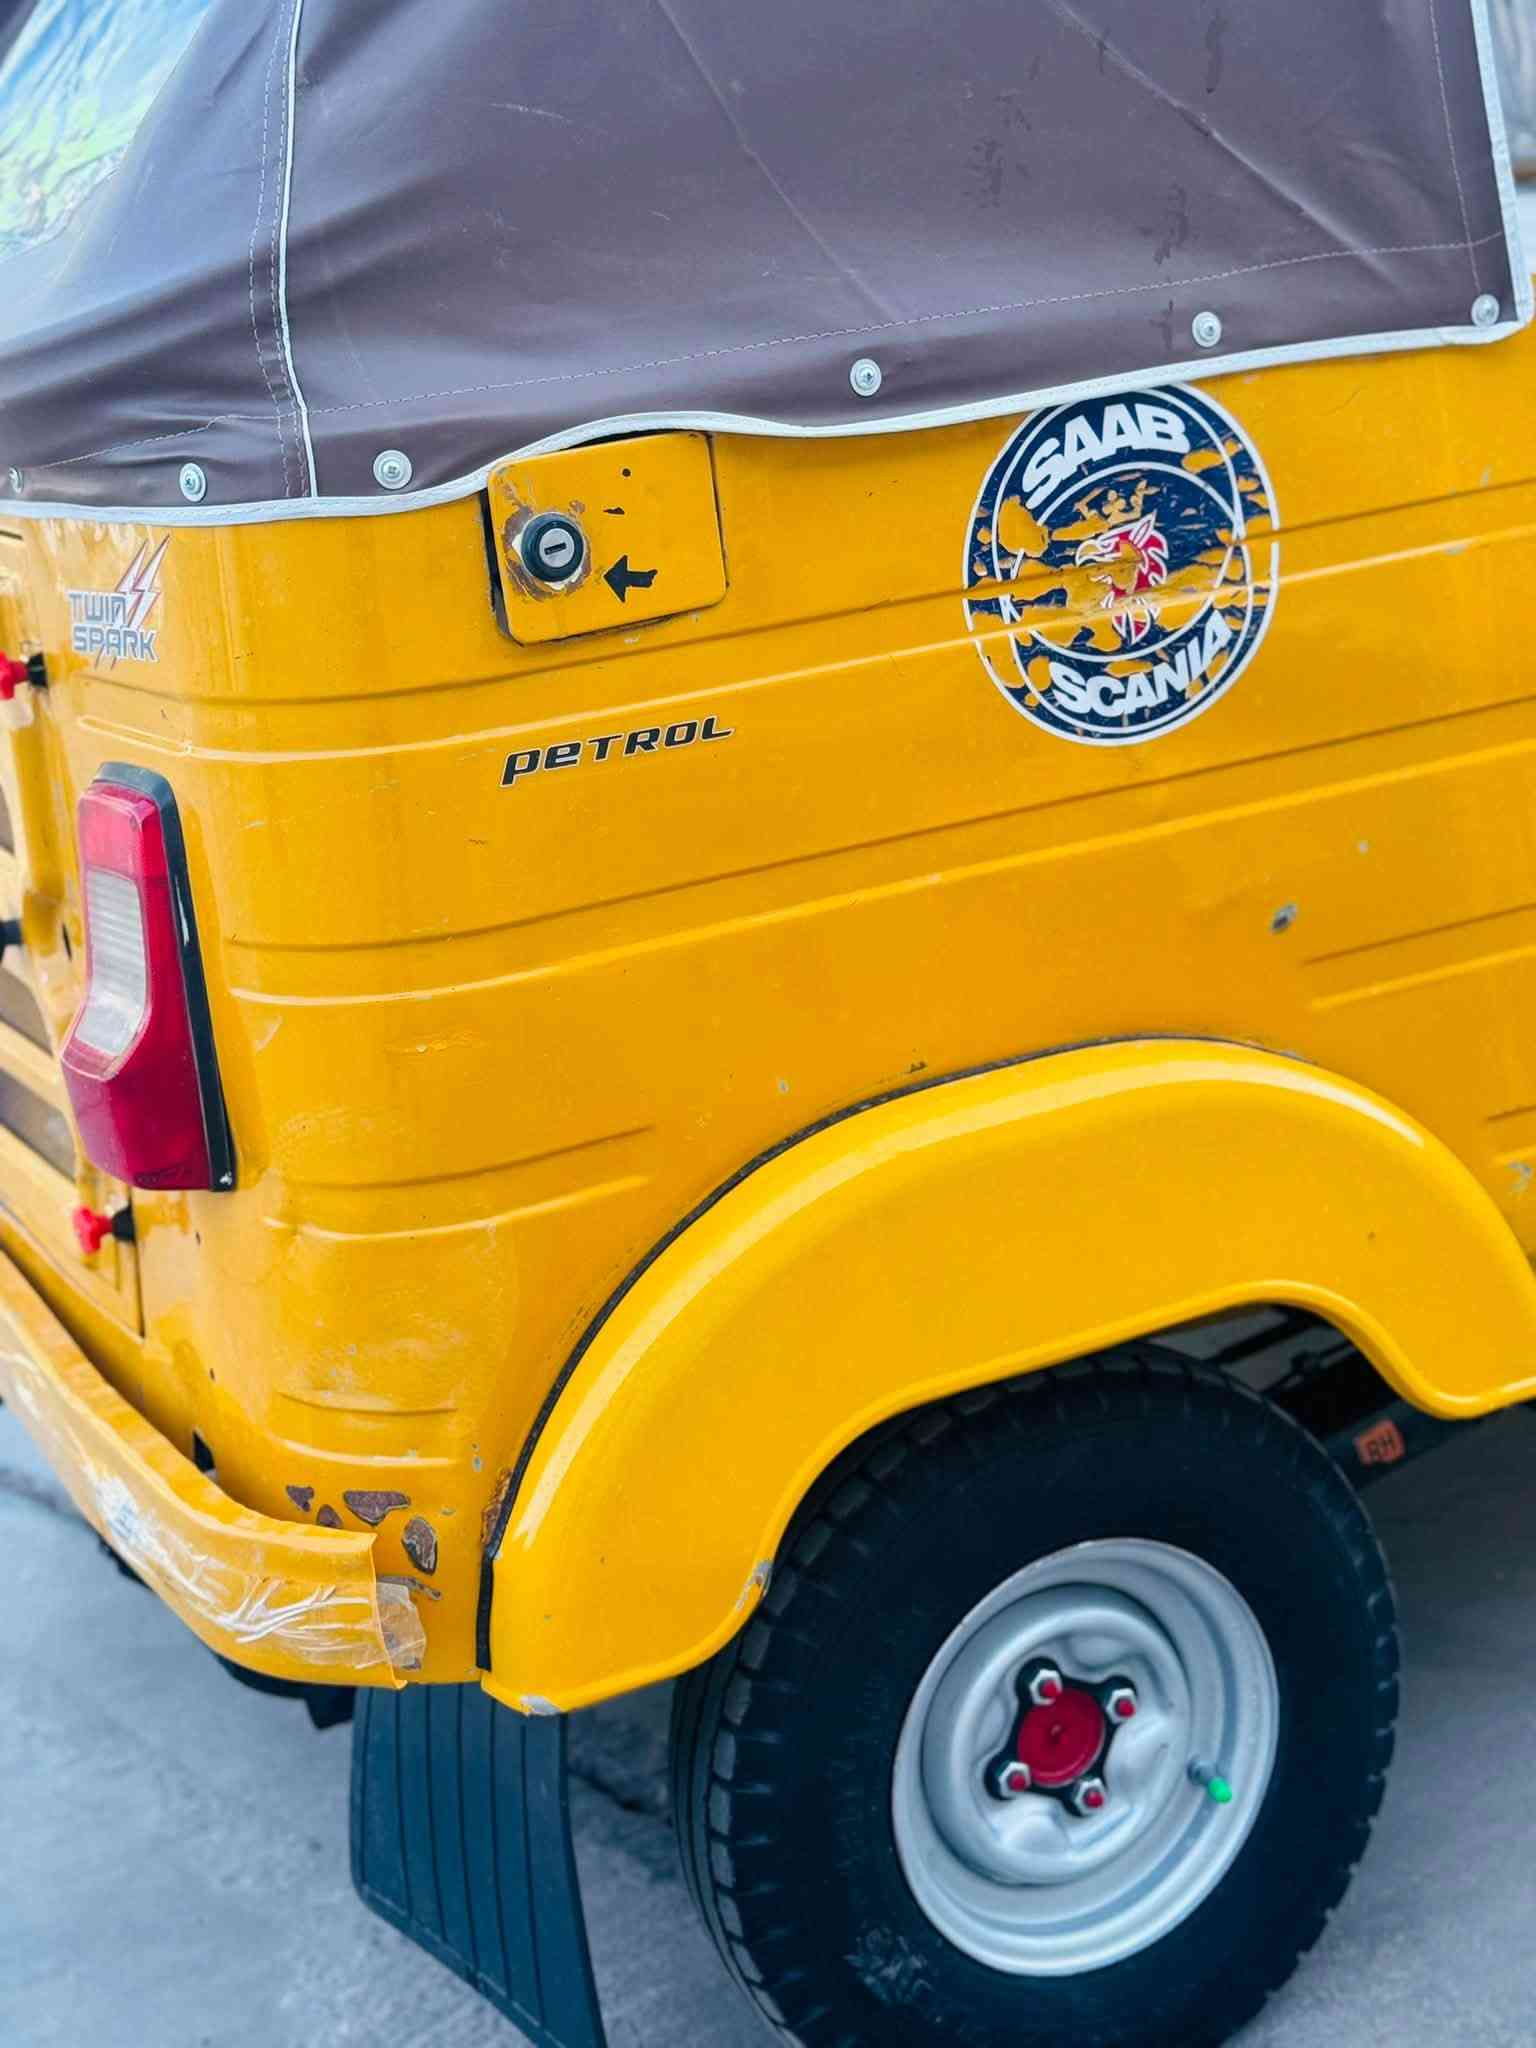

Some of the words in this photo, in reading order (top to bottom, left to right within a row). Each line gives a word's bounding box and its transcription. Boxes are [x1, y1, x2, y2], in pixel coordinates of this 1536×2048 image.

[1023, 404, 1189, 509] SAAB
[73, 624, 157, 660] SPARK
[1050, 610, 1231, 716] SCANIA
